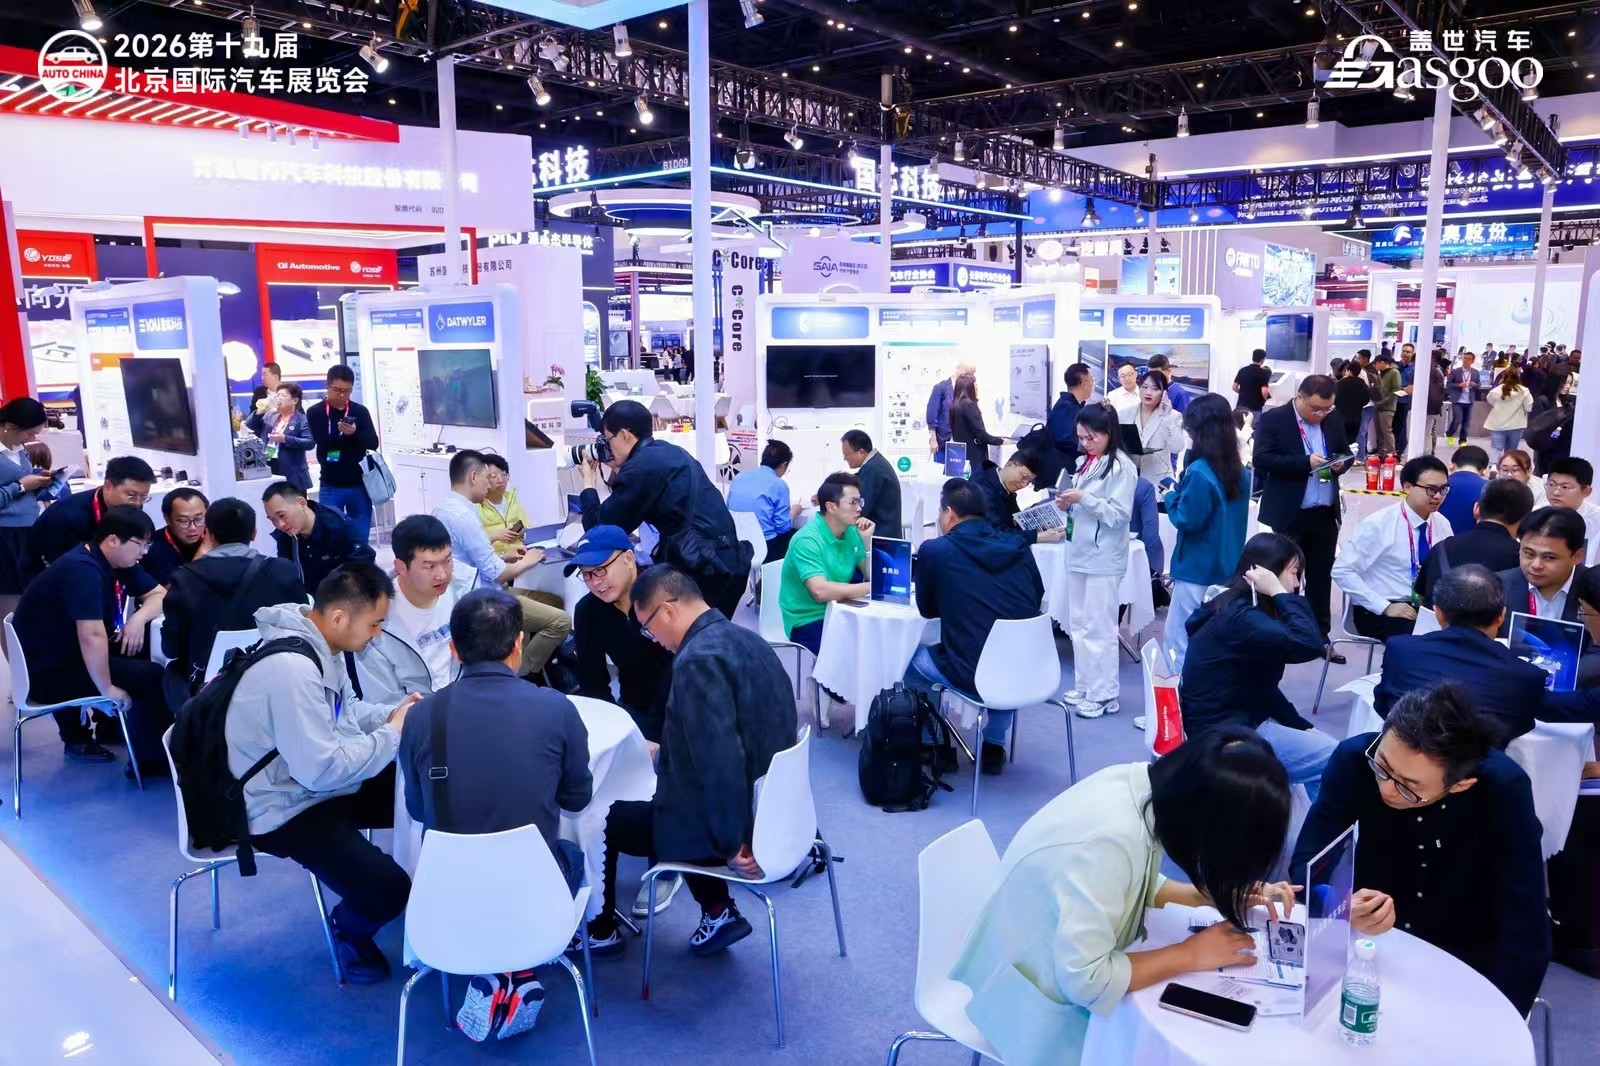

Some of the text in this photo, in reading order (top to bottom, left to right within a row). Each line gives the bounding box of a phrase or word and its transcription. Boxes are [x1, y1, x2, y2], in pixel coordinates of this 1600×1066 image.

[1421, 222, 1508, 243] 奥股份
[289, 263, 341, 271] Automotive
[446, 316, 487, 327] DATWYLER
[1126, 314, 1192, 326] SONGKE
